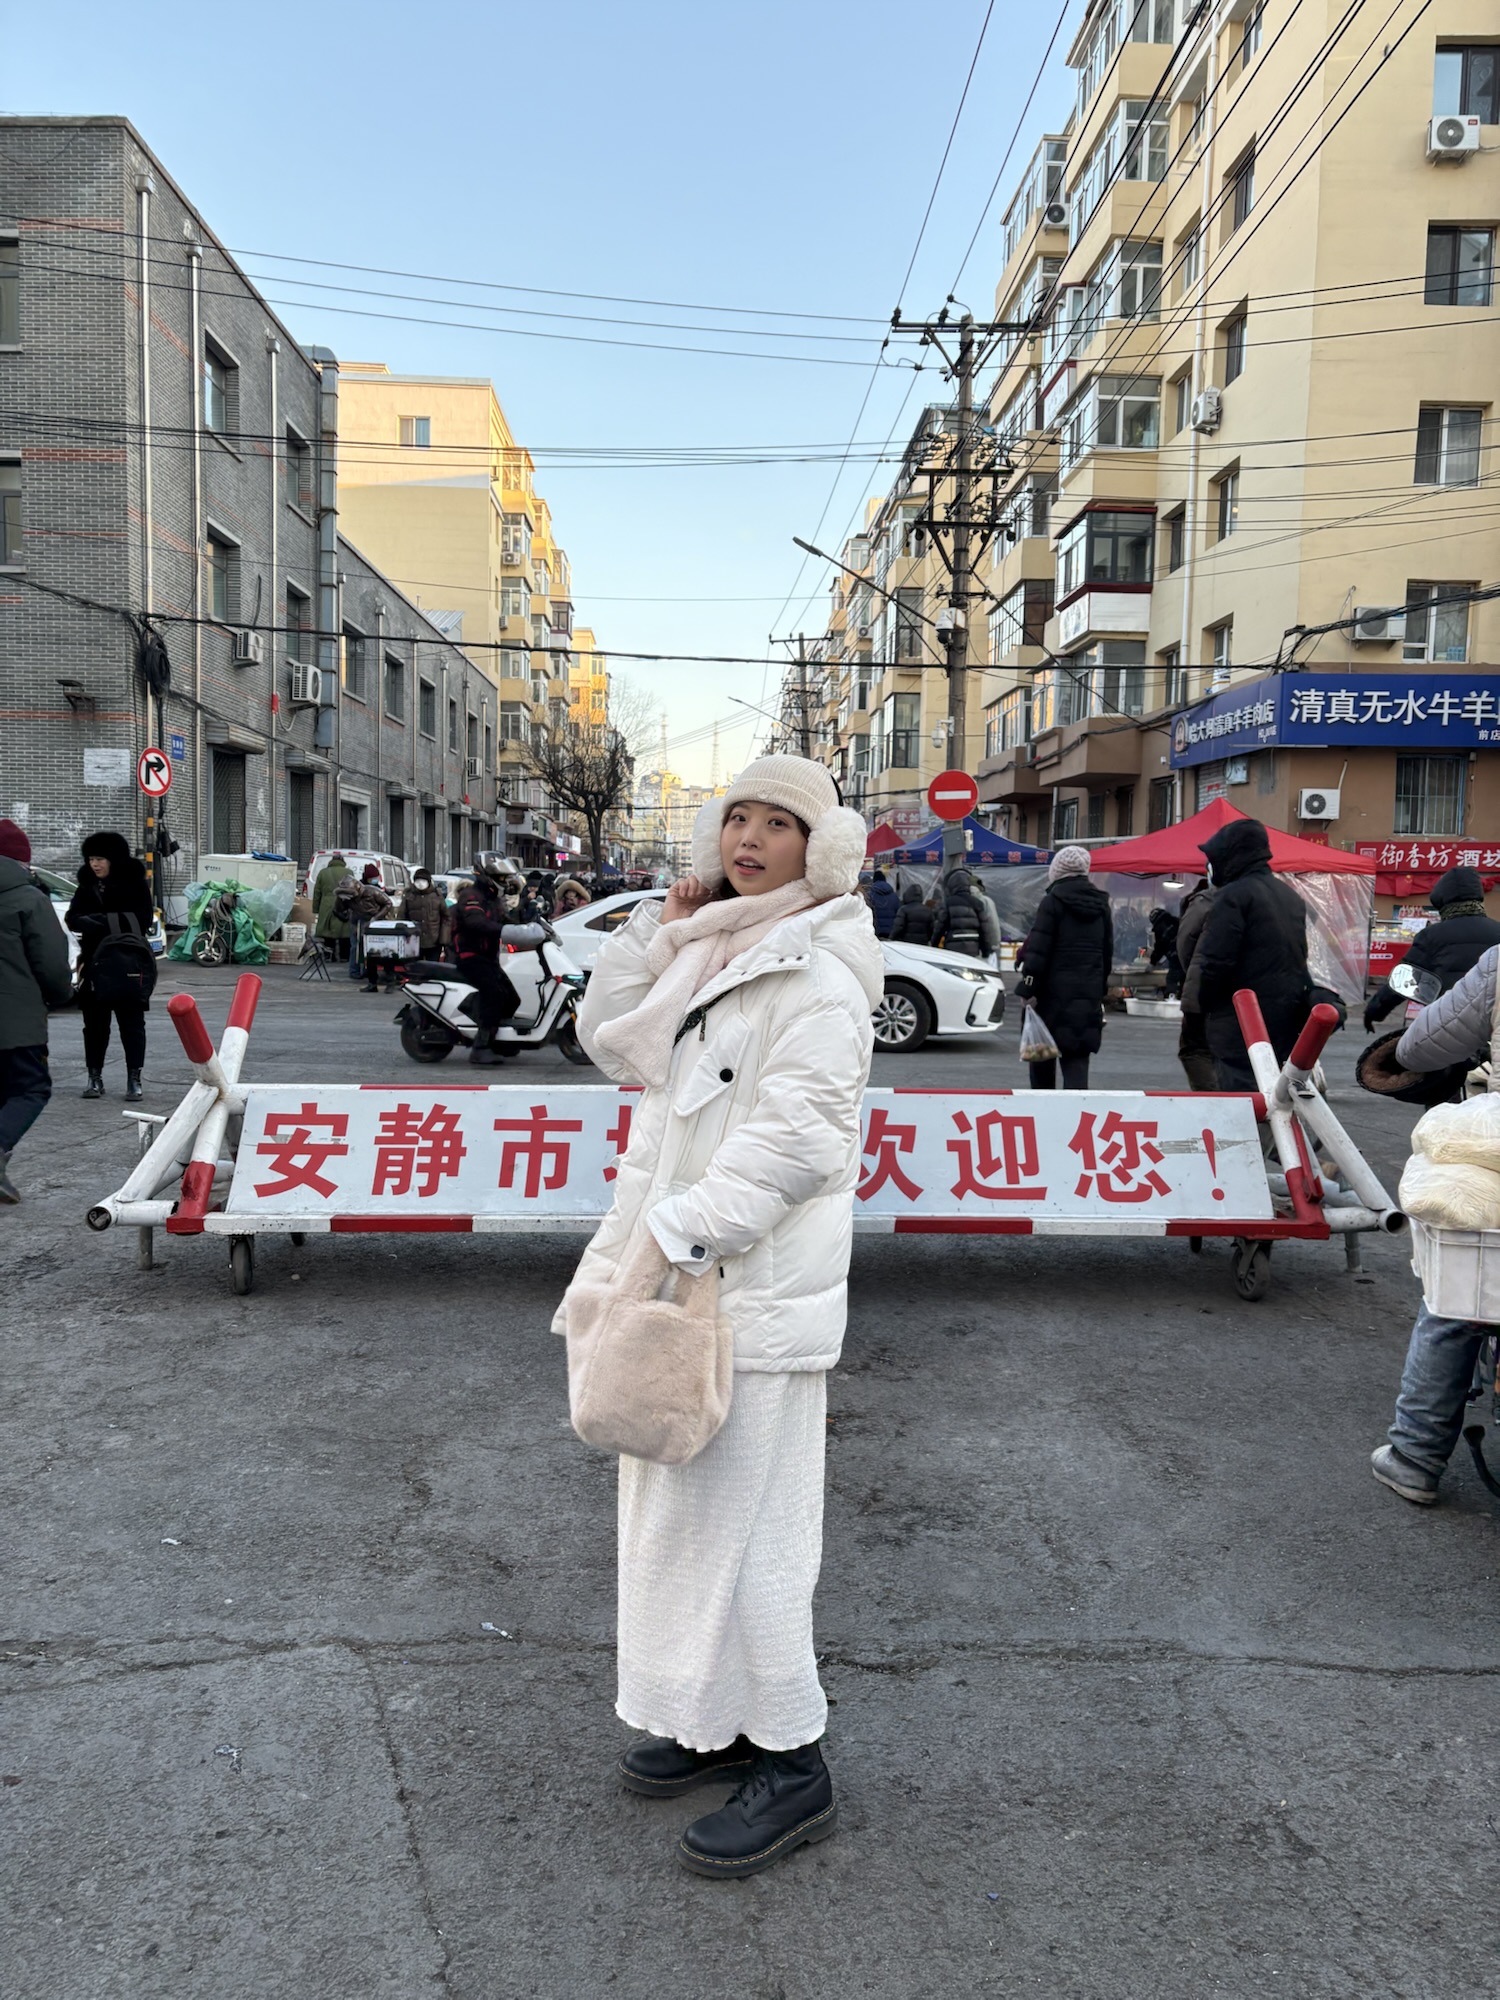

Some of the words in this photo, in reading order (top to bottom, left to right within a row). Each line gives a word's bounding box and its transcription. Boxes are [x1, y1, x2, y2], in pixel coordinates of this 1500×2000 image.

[1290, 689, 1500, 726] 清真无水牛羊
[1376, 843, 1453, 870] 御香坊
[253, 1102, 632, 1199] 安静市
